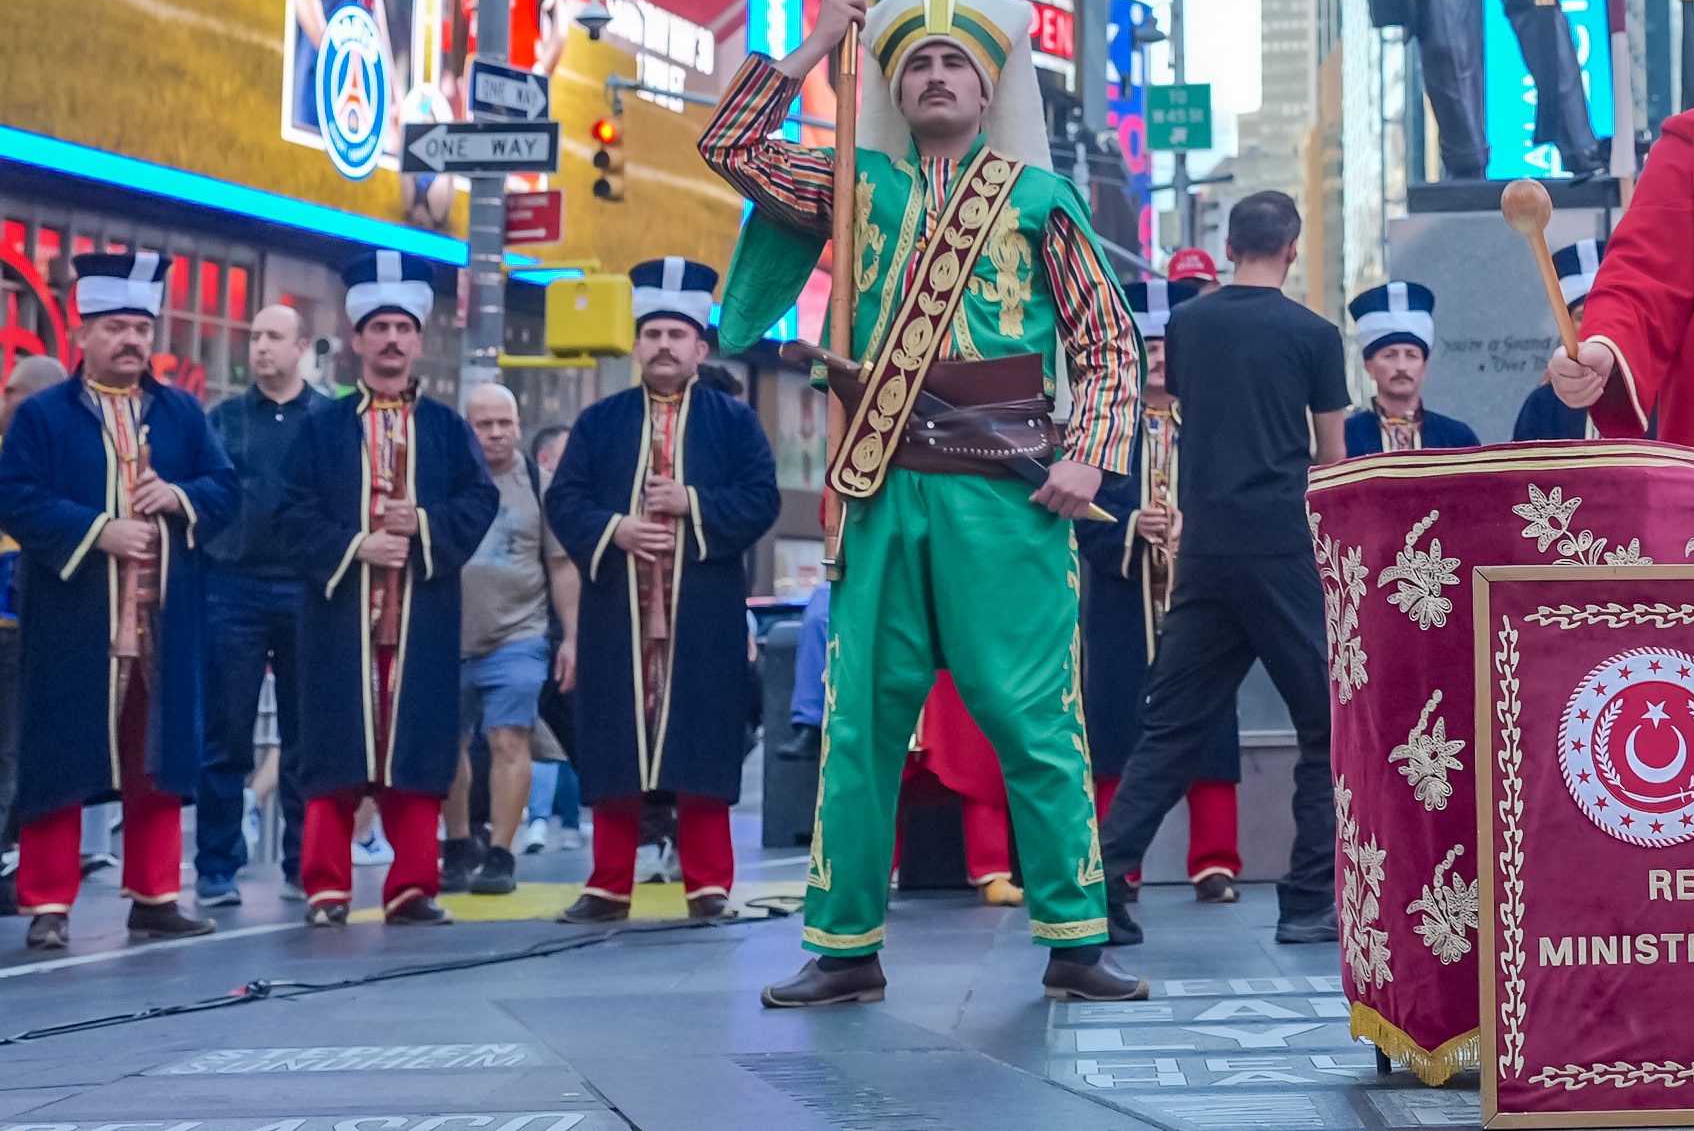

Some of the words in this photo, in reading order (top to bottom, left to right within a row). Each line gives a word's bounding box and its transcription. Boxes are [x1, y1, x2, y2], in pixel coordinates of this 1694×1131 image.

[425, 138, 469, 158] ONE
[491, 137, 538, 157] WAY
[208, 1043, 522, 1061] STEPHEN
